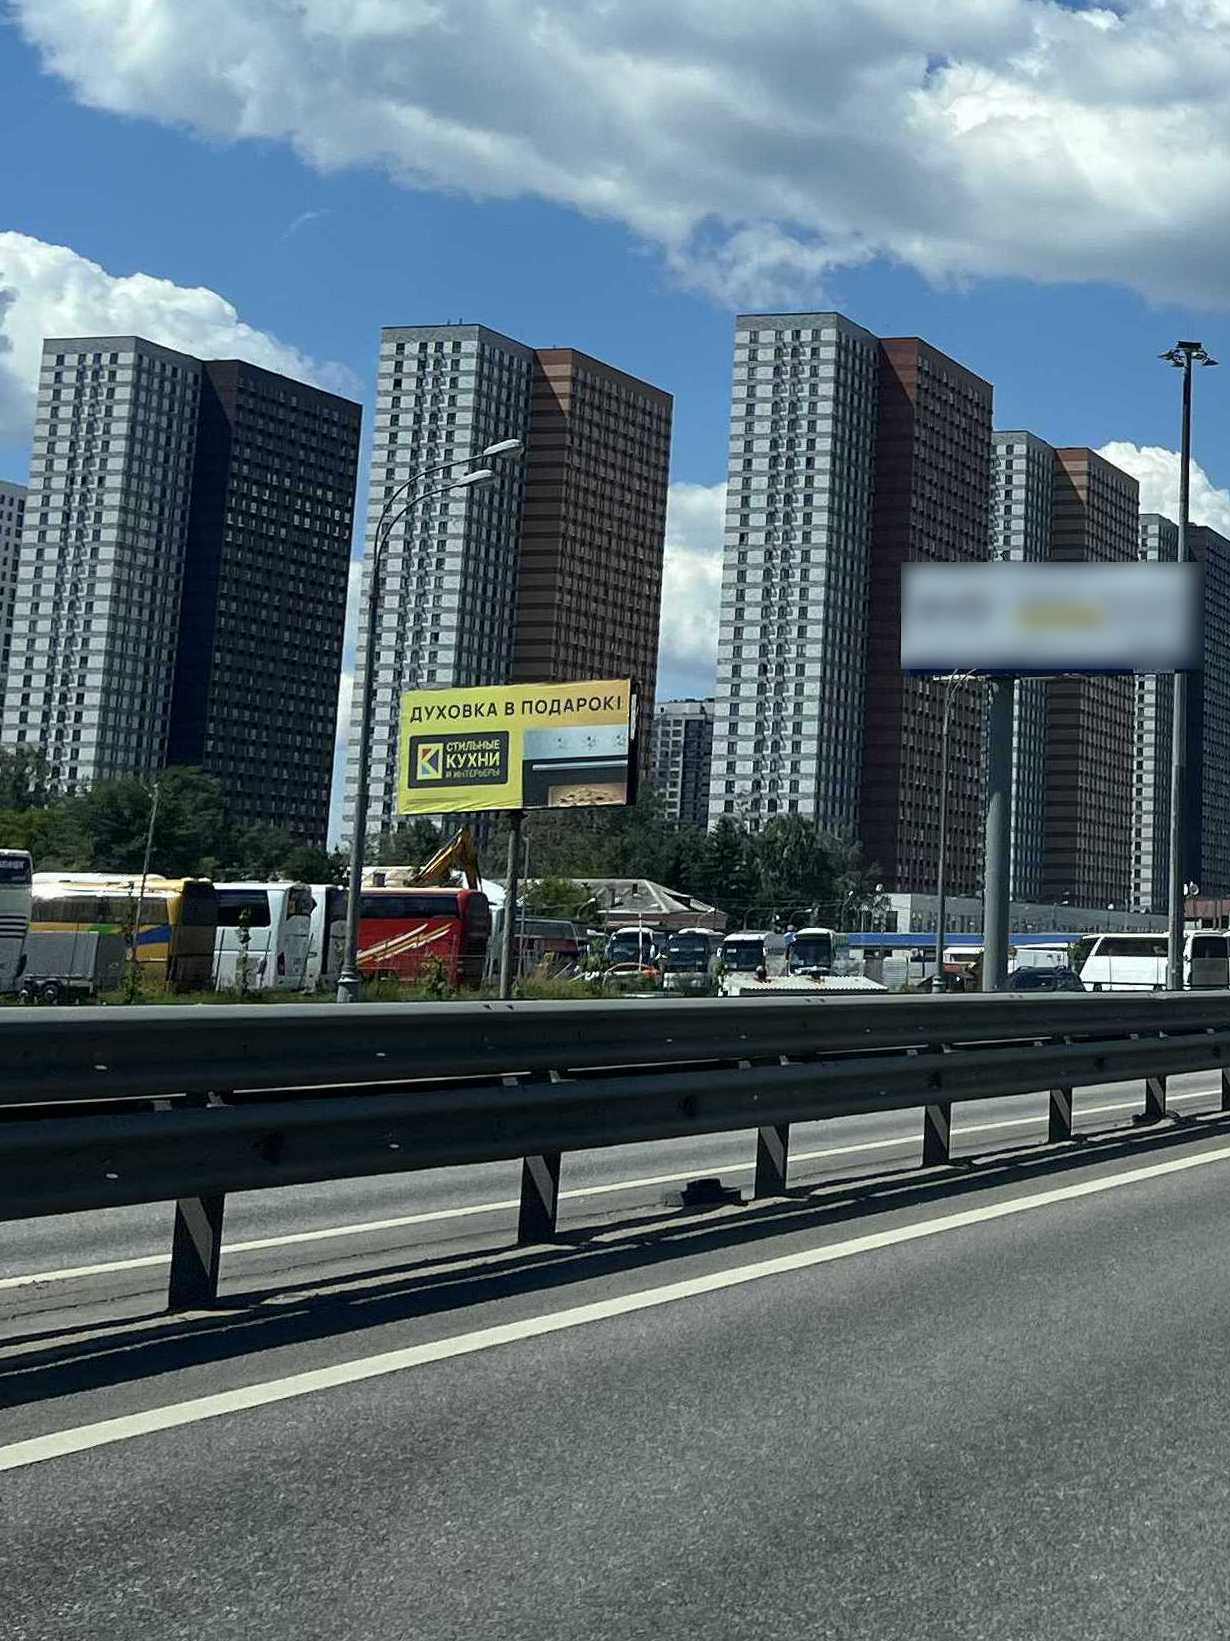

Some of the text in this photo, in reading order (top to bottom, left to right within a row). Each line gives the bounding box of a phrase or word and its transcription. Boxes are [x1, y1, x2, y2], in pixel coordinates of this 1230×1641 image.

[410, 695, 622, 724] ДУХОВКА В ПОДАРОК!
[446, 739, 501, 752] СТИЛЬНЫЕ
[446, 751, 501, 769] КУХНИ
